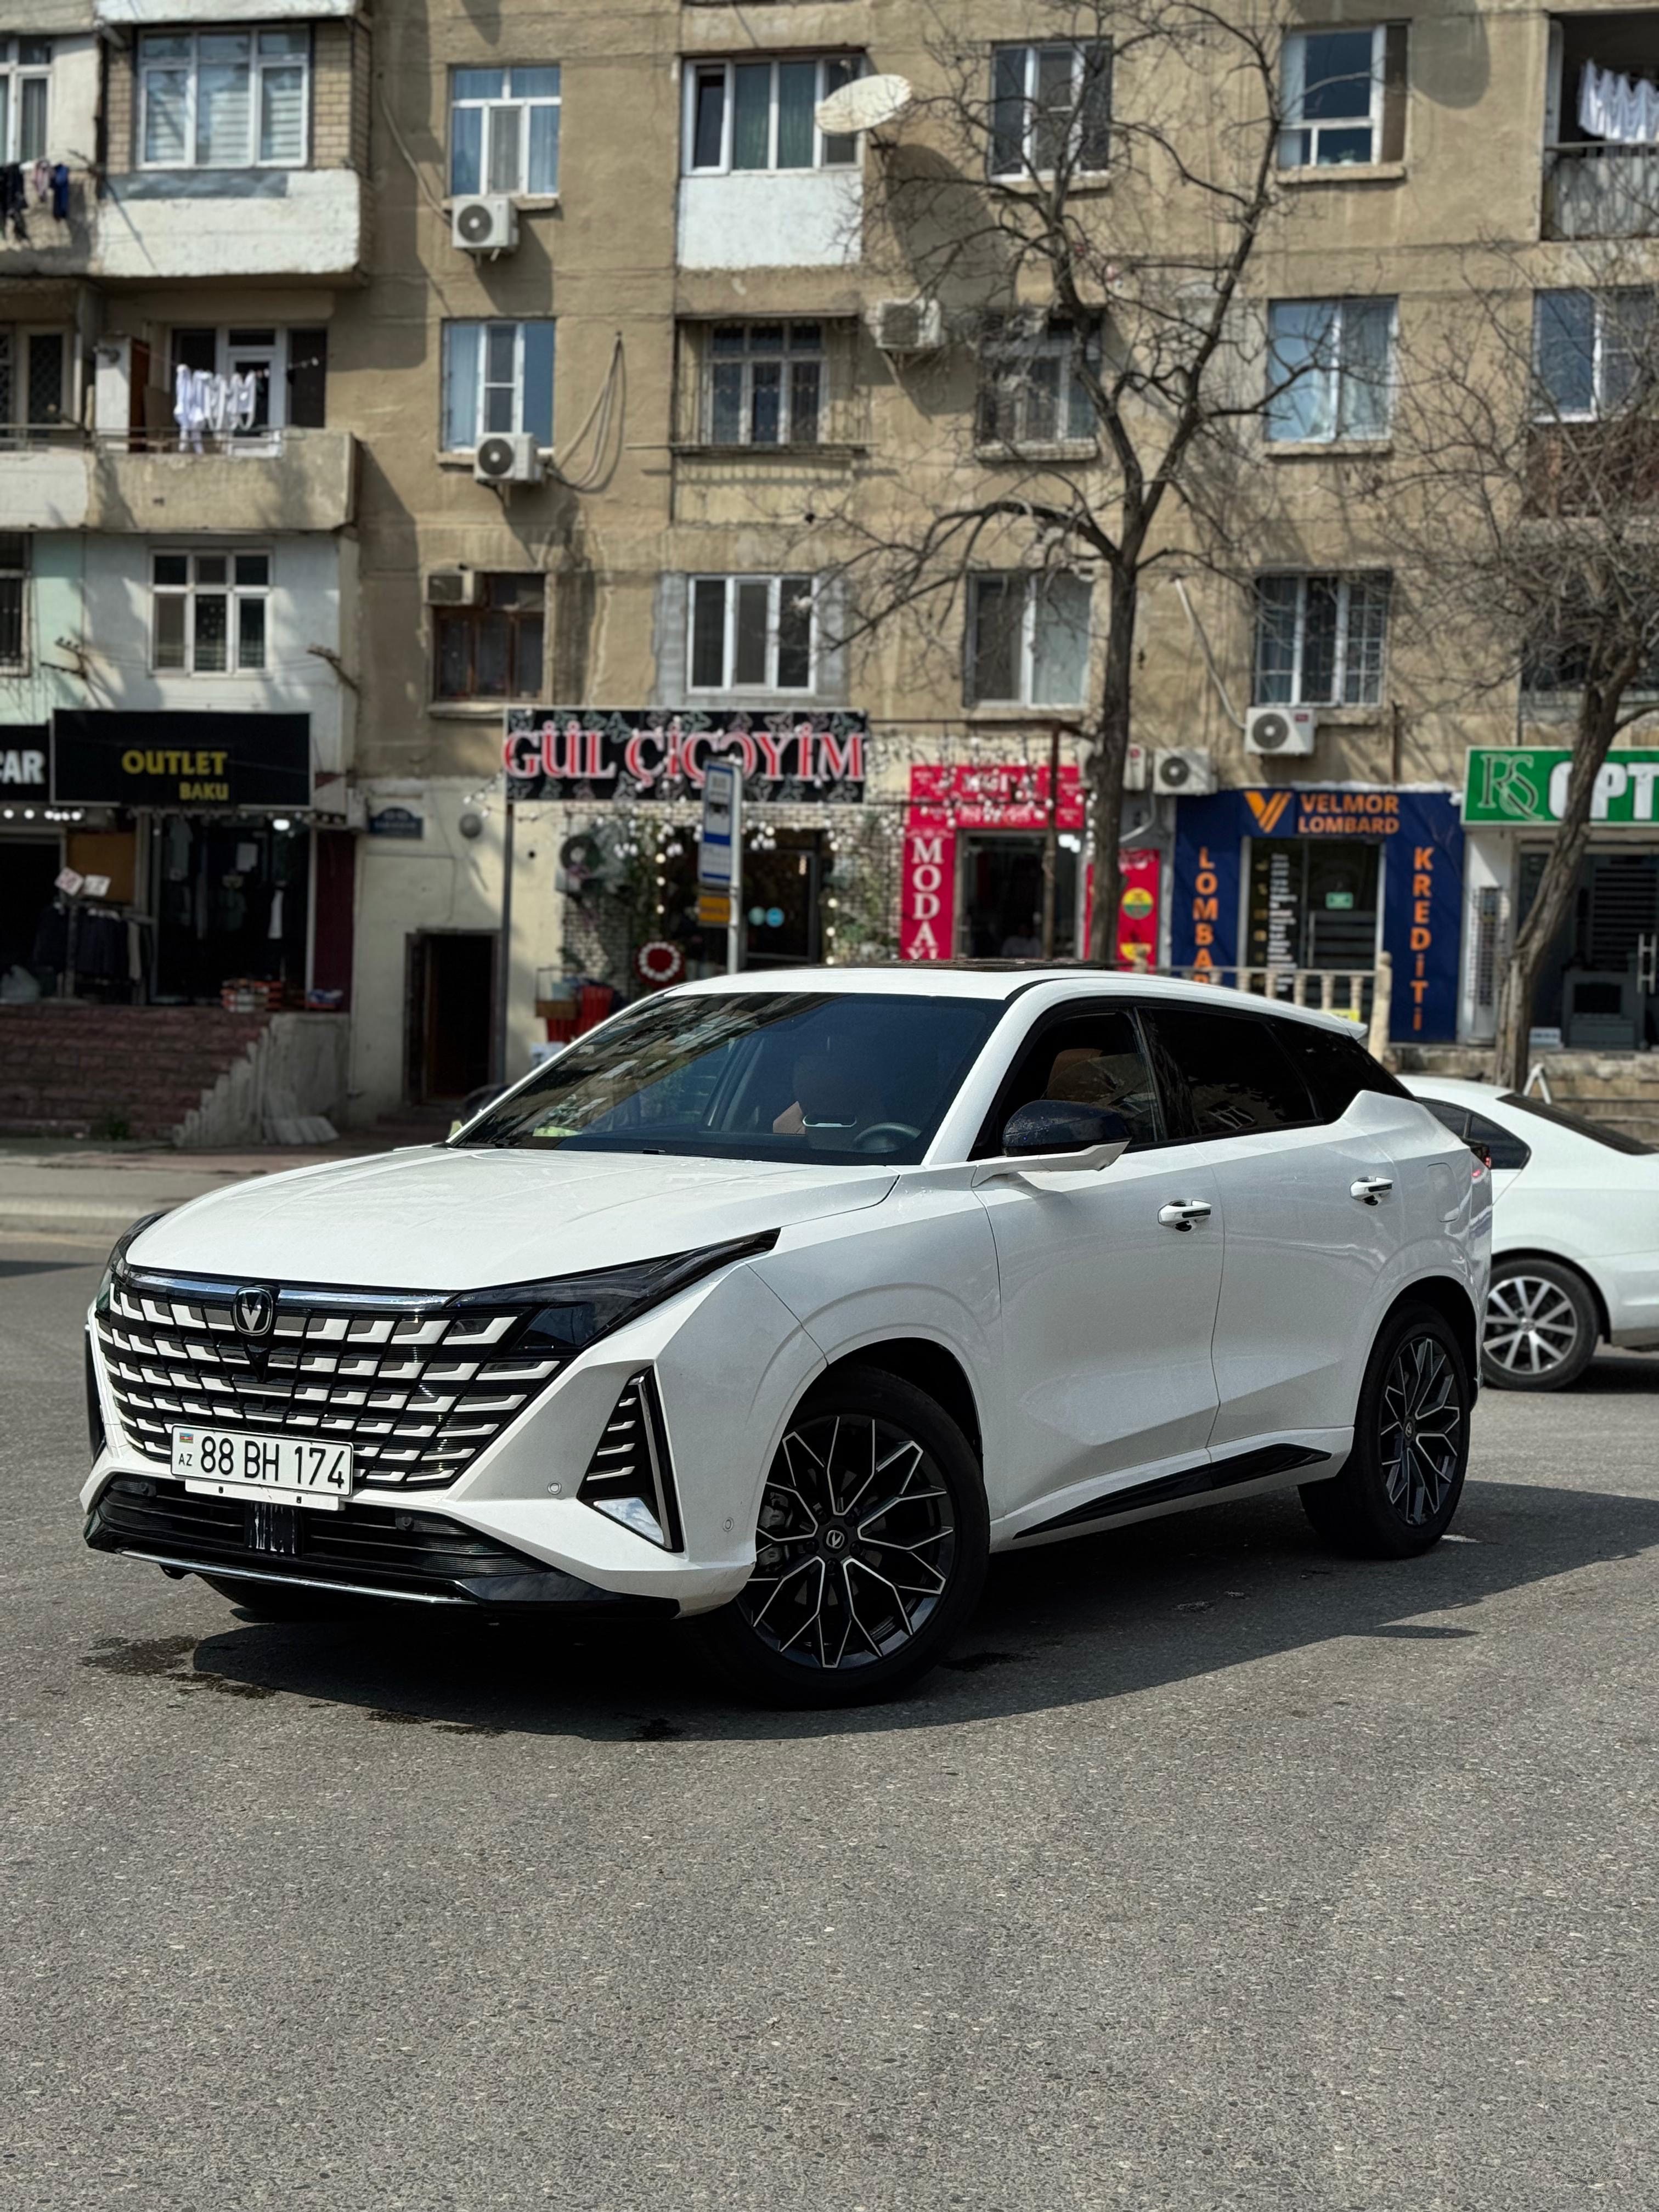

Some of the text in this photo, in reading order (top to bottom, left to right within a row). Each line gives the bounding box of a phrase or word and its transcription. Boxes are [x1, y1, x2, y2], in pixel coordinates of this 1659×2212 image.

[121, 749, 228, 775] OUTLET
[503, 720, 617, 778] GÜL
[0, 749, 45, 784] AR
[179, 782, 229, 801] BAKU
[1300, 793, 1400, 814] VELMOR
[1297, 816, 1400, 834] LOMBARD
[178, 1436, 345, 1489] AZ 88 BH 174
